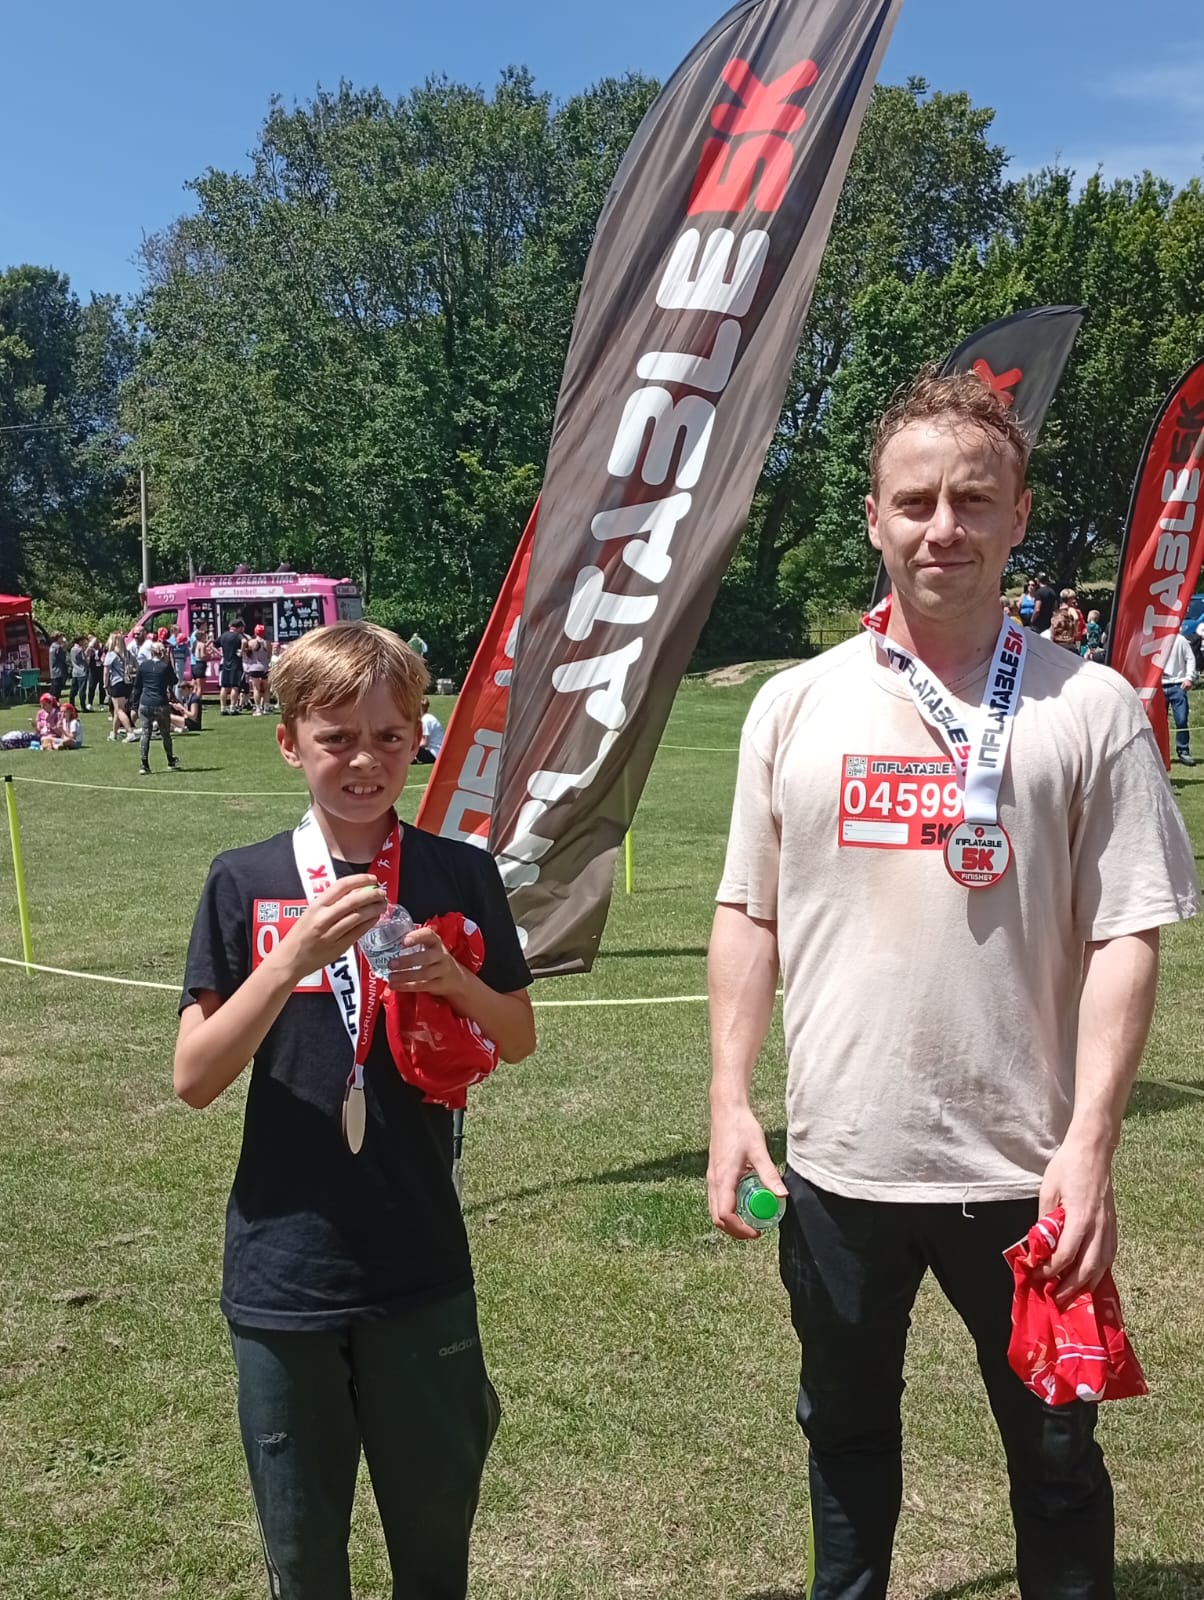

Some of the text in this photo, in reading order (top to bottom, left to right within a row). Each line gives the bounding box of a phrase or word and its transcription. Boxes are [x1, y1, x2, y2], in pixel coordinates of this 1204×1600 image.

[219, 576, 233, 586] ICE
[235, 575, 267, 585] CREAM
[271, 575, 295, 584] TIME
[843, 779, 963, 818] 04599
[955, 838, 1003, 848] INFLATABLE
[961, 848, 995, 871] 5K
[961, 872, 993, 882] FINISHER
